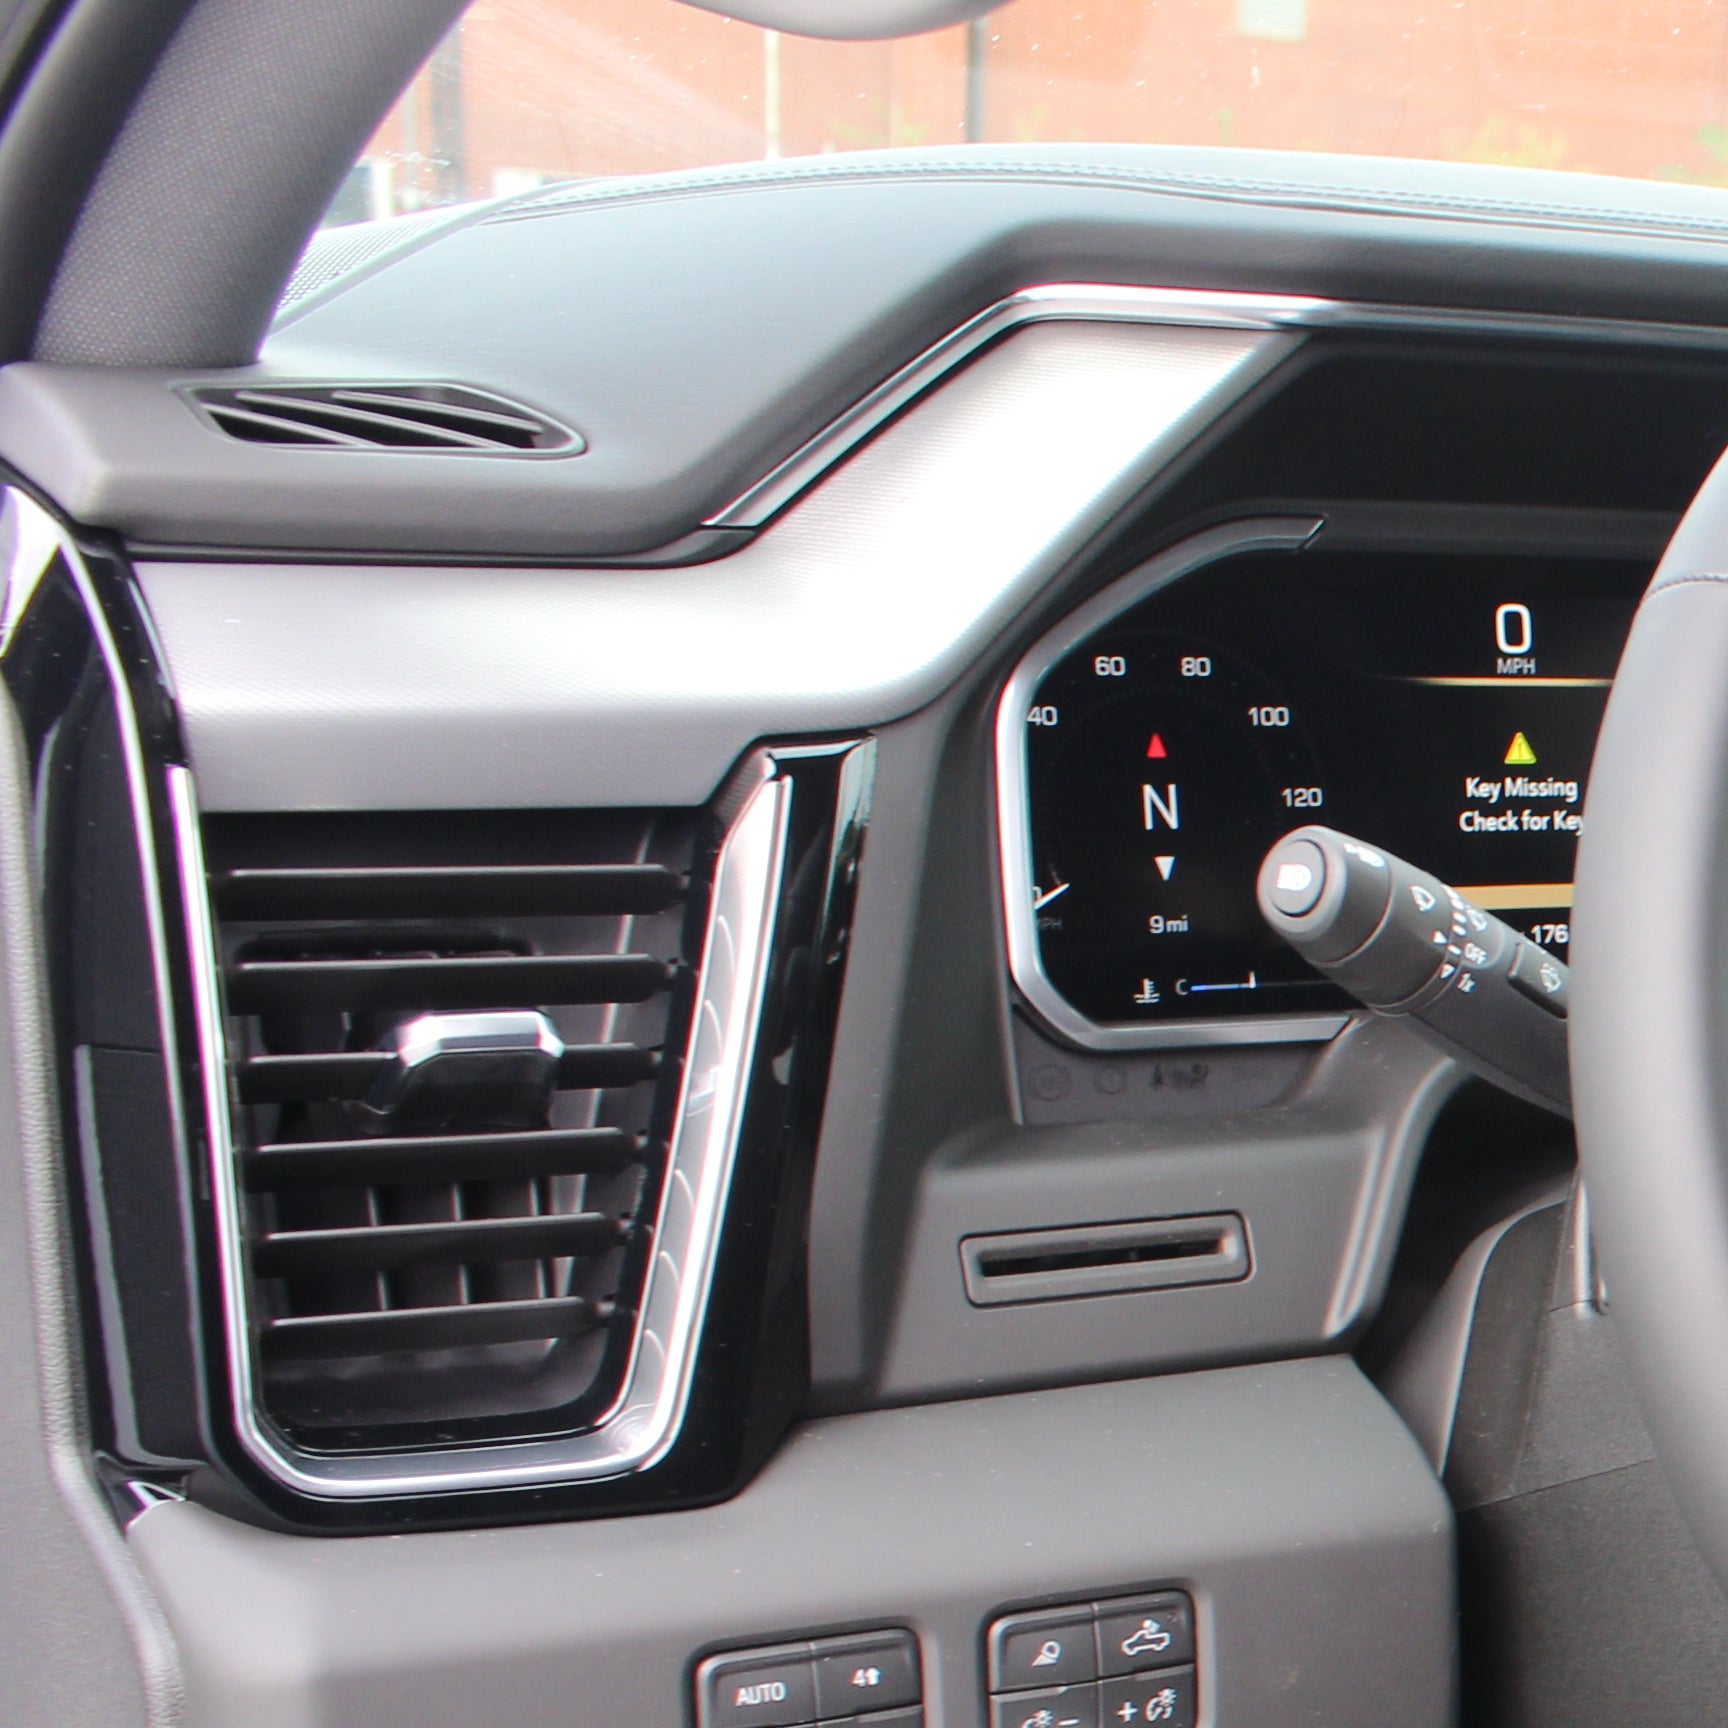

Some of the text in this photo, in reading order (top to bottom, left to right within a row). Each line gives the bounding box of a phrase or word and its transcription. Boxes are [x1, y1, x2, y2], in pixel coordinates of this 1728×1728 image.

[1494, 603, 1533, 655] 0
[1095, 656, 1126, 677] 60
[1181, 657, 1211, 677] 80
[1496, 658, 1536, 674] MPH
[1027, 706, 1058, 727] 40
[1248, 707, 1290, 728] 100
[1281, 787, 1323, 807] 120
[1466, 777, 1579, 803] Key Missing
[1141, 783, 1180, 831] N
[1459, 810, 1519, 832] Check
[1522, 809, 1550, 831] for
[1530, 923, 1570, 944] 176
[1464, 942, 1487, 965] OFF
[1175, 978, 1188, 996] C
[735, 1681, 787, 1707] AUTO
